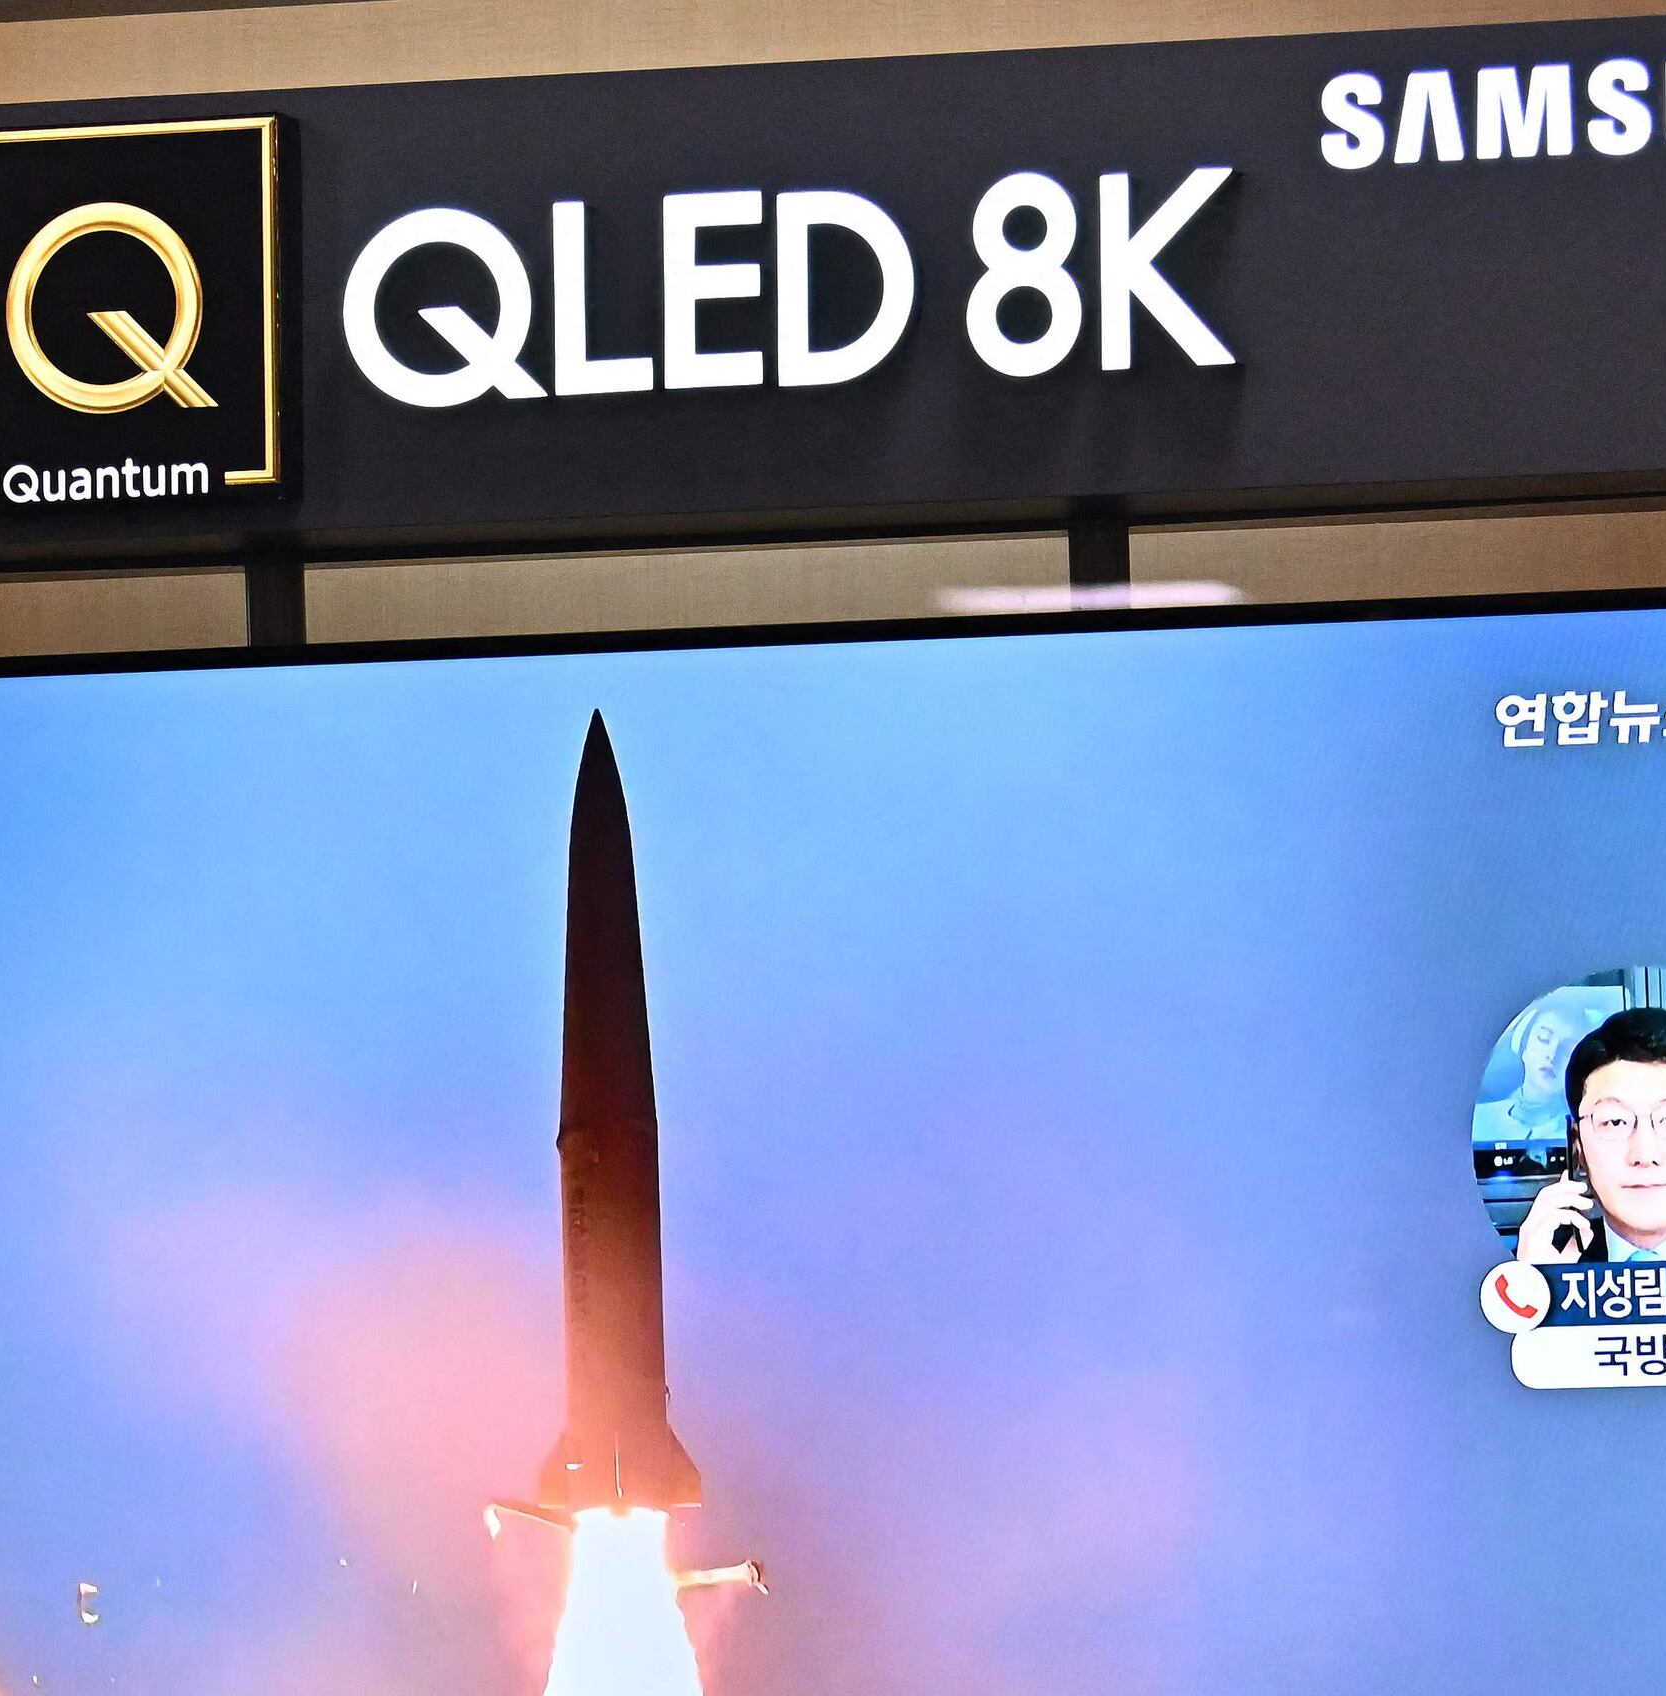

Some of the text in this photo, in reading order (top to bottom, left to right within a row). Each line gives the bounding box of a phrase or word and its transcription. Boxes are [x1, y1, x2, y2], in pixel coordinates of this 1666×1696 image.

[5, 201, 219, 410] Q
[342, 167, 1236, 408] QLED 8K
[2, 457, 209, 504] Quantum
